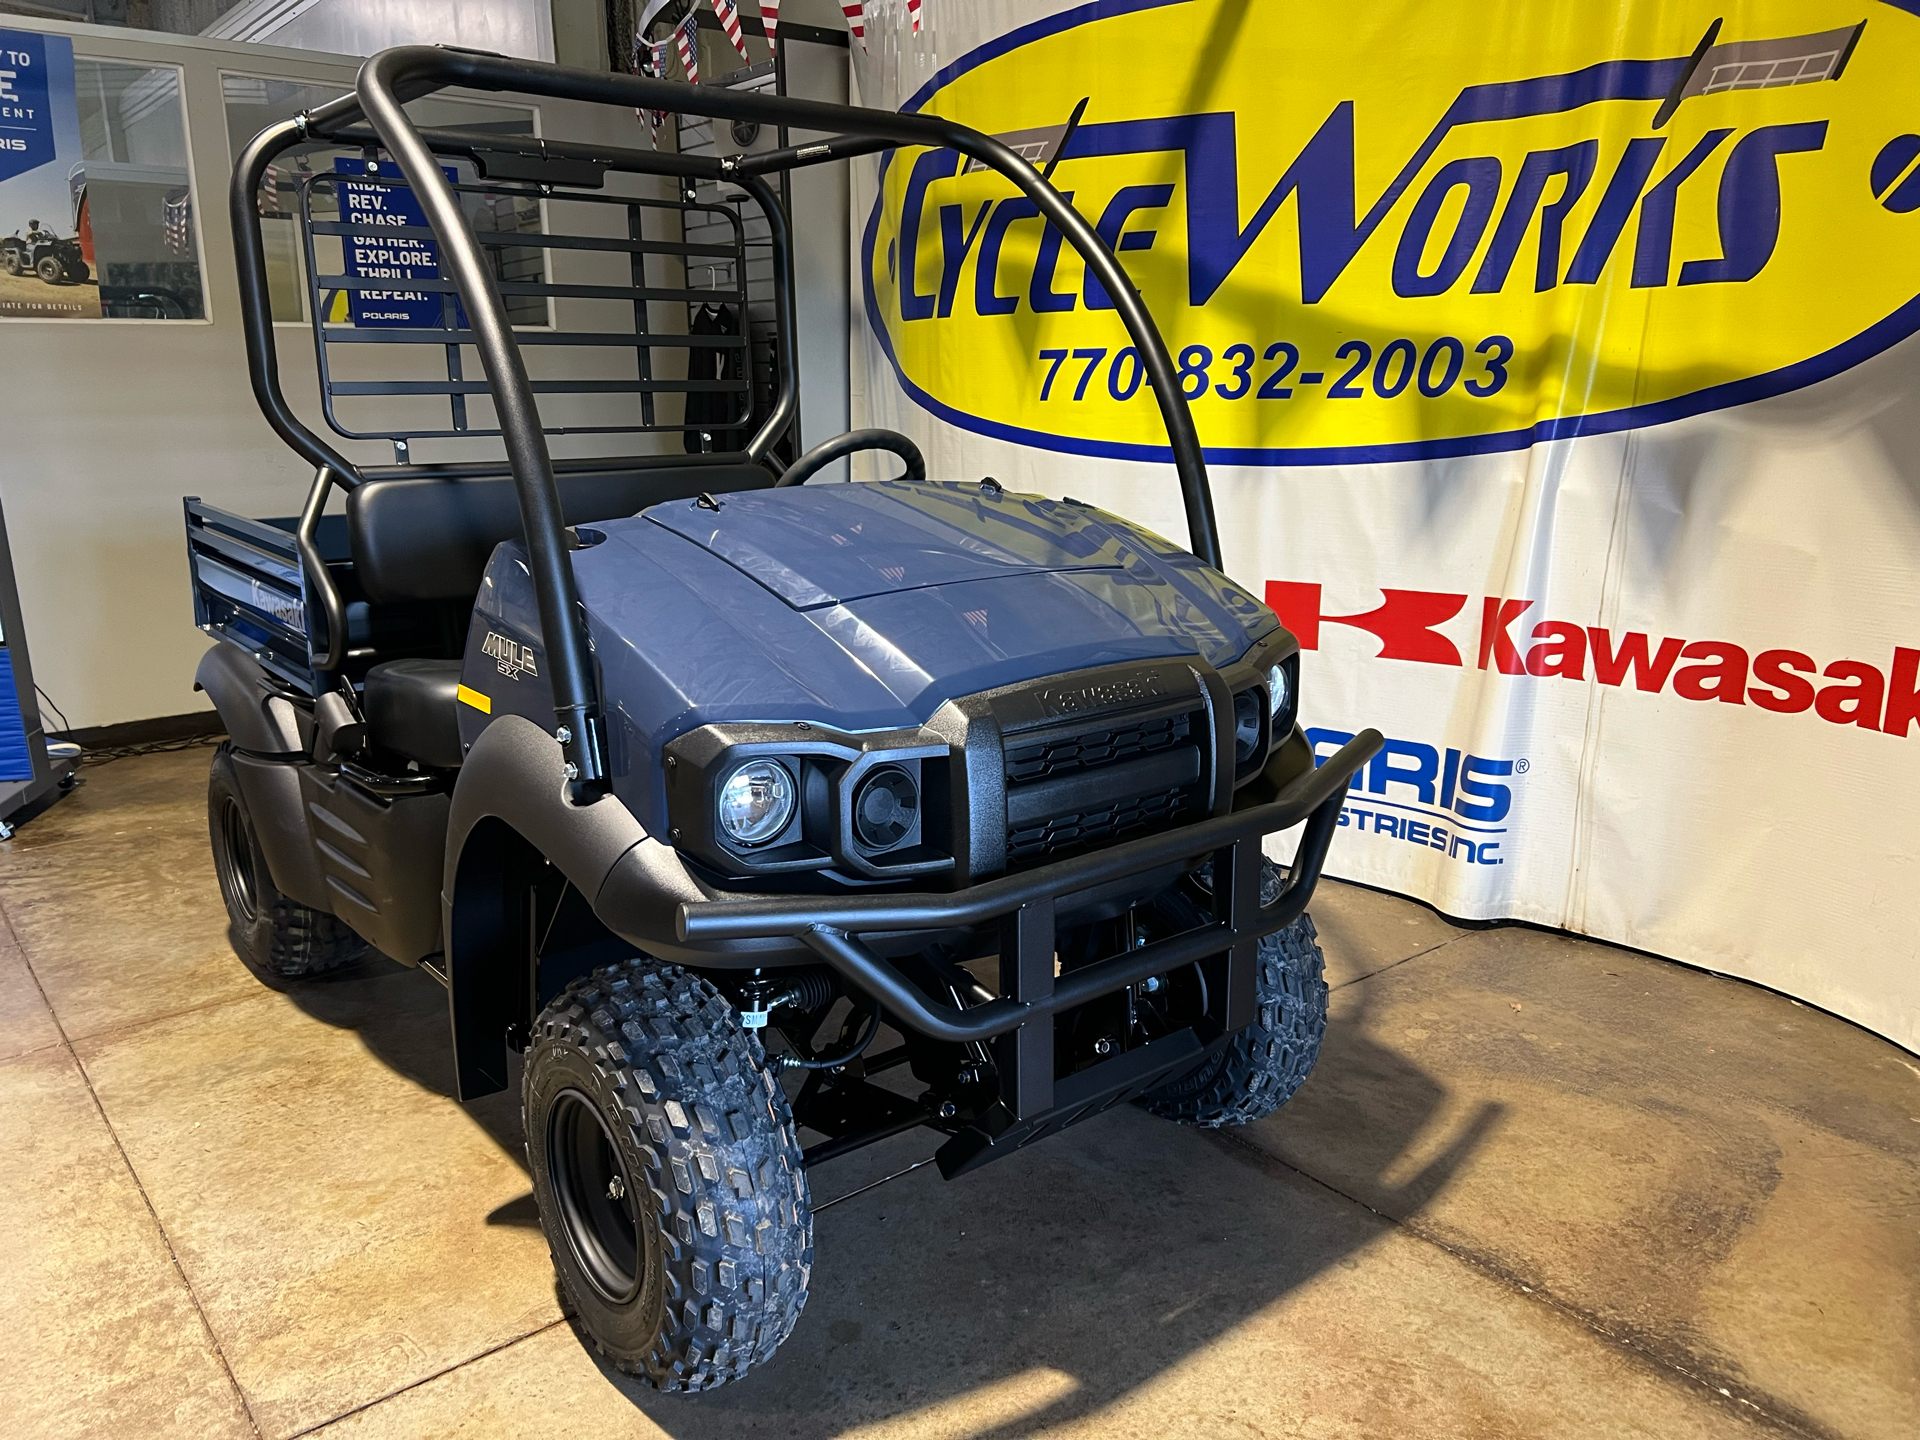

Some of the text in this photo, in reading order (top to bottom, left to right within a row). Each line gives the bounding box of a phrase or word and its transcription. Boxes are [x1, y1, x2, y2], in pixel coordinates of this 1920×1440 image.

[7, 51, 31, 66] TO
[348, 193, 388, 211] REV.
[355, 249, 437, 266] EXPLORE.
[362, 312, 410, 320] POLARIS
[481, 631, 538, 677] MULE
[497, 660, 519, 681] SX
